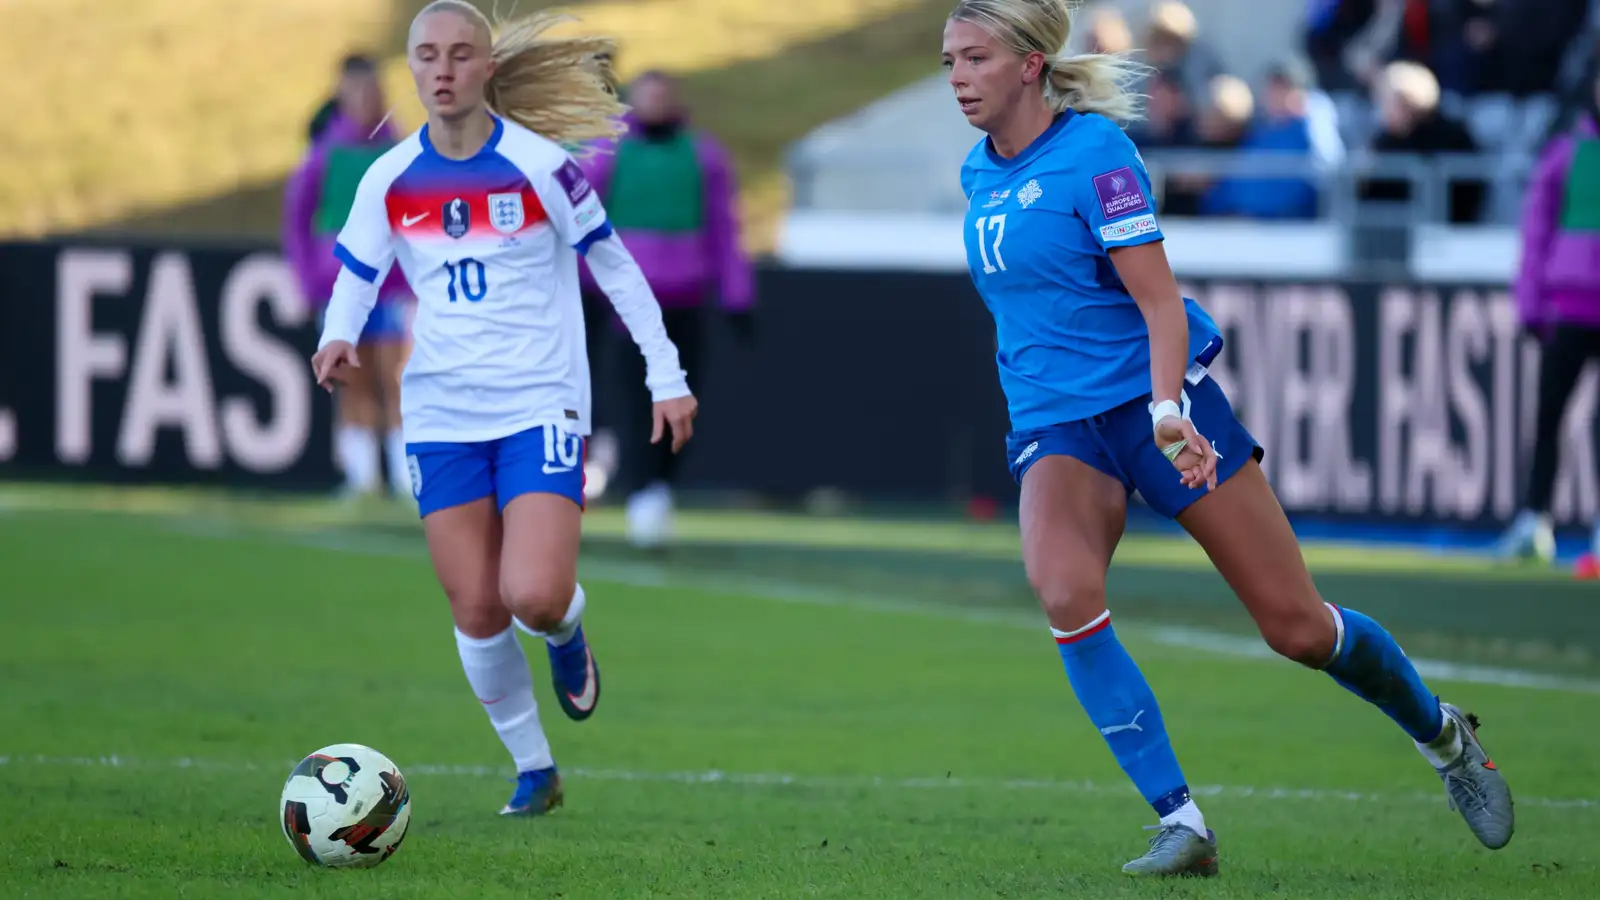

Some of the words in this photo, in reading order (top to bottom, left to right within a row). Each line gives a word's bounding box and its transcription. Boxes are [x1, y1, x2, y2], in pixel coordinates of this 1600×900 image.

[1106, 193, 1140, 208] EUROPEAN
[1107, 198, 1142, 213] QUALIFIERS
[975, 213, 1008, 275] 17
[442, 257, 487, 302] 10
